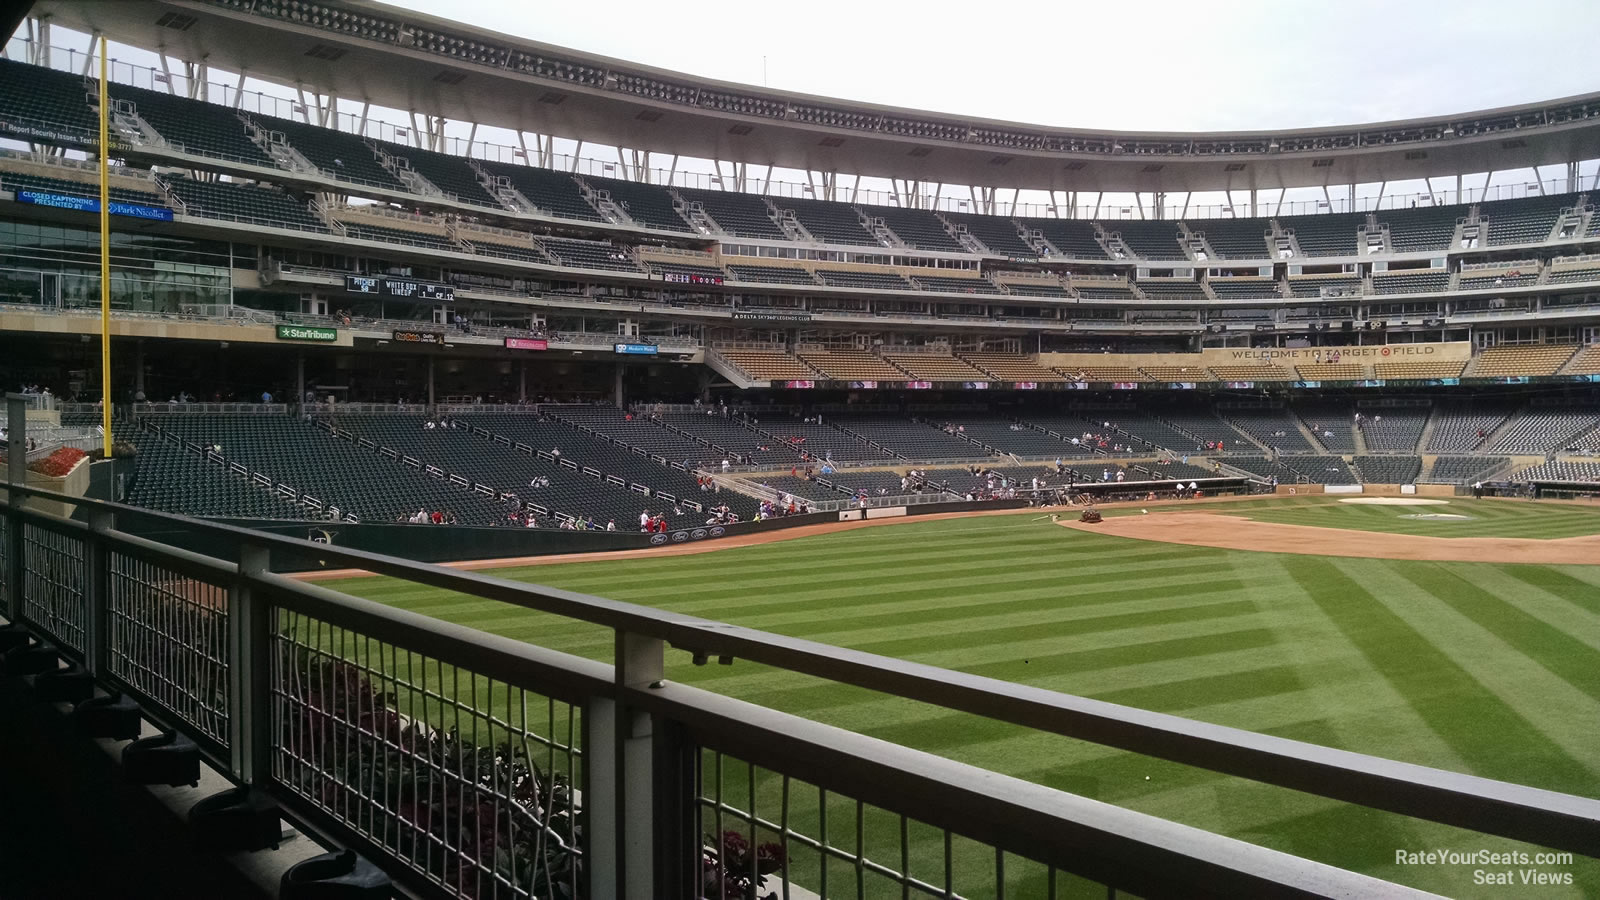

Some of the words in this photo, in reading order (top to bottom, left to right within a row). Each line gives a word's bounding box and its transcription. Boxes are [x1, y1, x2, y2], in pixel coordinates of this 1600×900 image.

[9, 124, 30, 134] Report
[31, 128, 56, 139] Security
[57, 133, 78, 142] Issues.
[80, 136, 91, 144] Text
[23, 191, 50, 200] CLOSED
[51, 195, 93, 205] CAPTIONING
[34, 199, 73, 208] PRESENTED
[117, 205, 135, 215] Park
[136, 206, 164, 218] Nicollet
[385, 281, 404, 289] WHITE
[405, 283, 417, 291] SOX
[391, 288, 412, 297] LINEUP
[290, 329, 335, 339] StarTribune
[1232, 350, 1299, 359] WELCOME
[1303, 350, 1321, 358] TO
[1325, 348, 1378, 357] TARGET
[1393, 346, 1434, 355] FIELD
